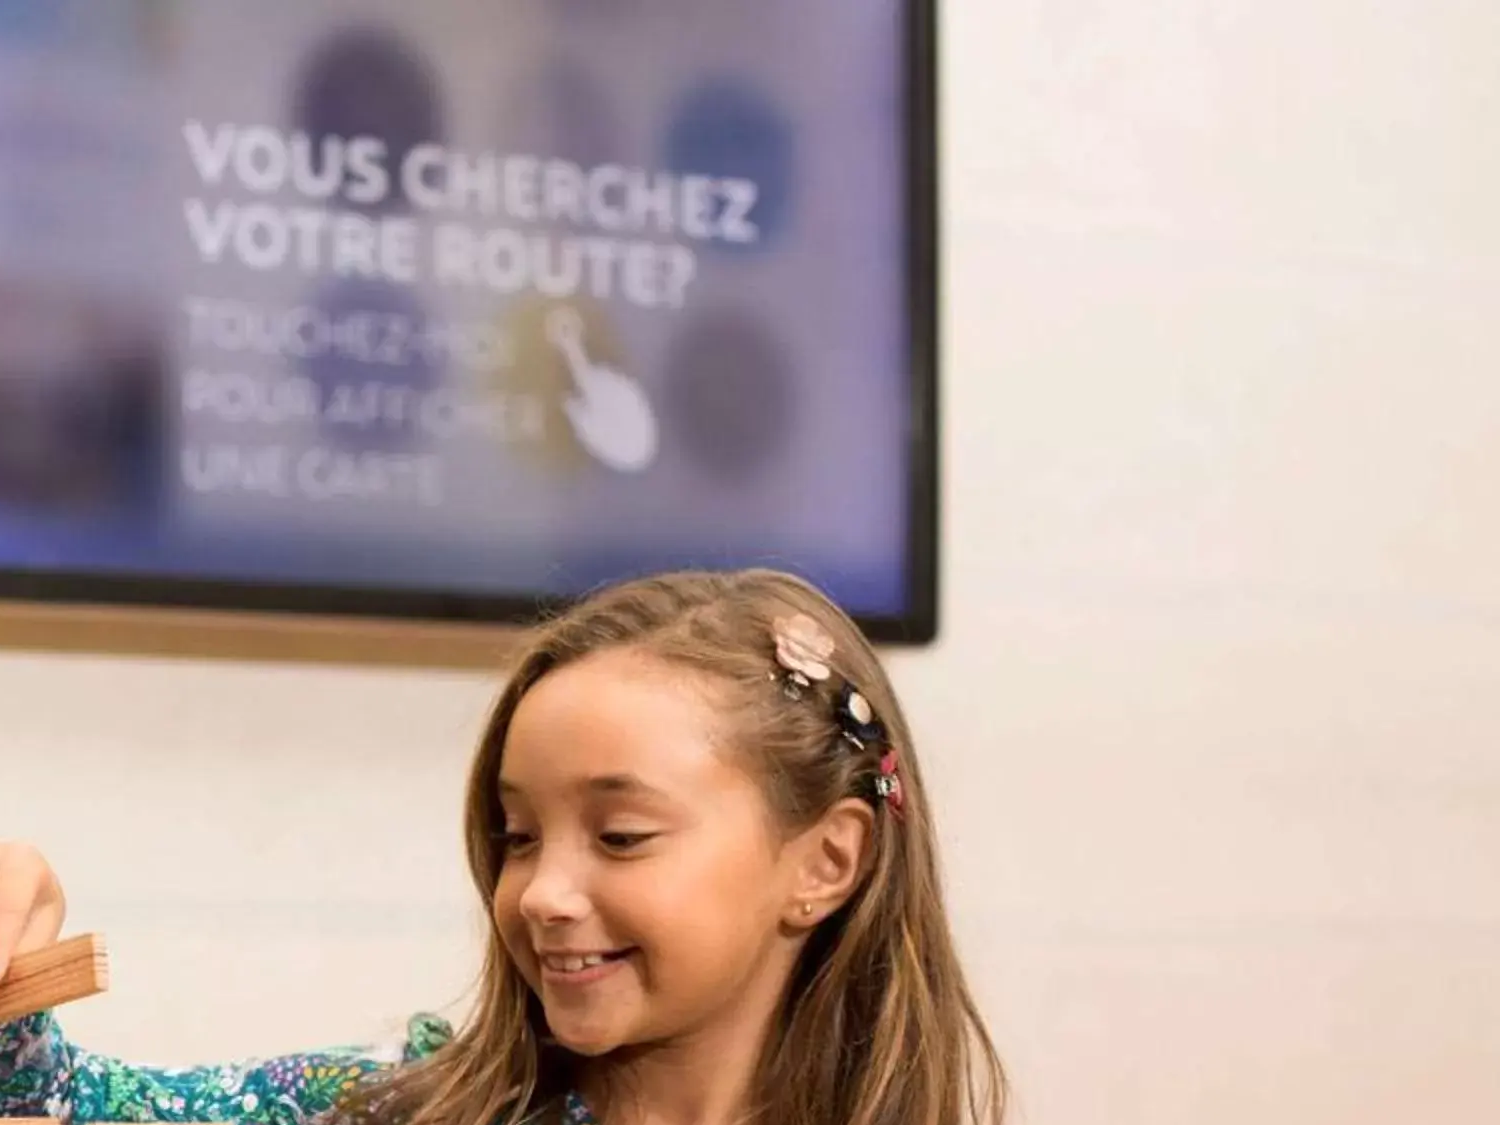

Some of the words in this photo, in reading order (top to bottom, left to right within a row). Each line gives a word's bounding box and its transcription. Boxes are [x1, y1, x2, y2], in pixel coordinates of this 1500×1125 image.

[181, 119, 388, 201] VOUS
[402, 144, 758, 242] CHERCHEZ
[183, 199, 417, 281] VOTRE
[433, 220, 697, 308] ROUTE?
